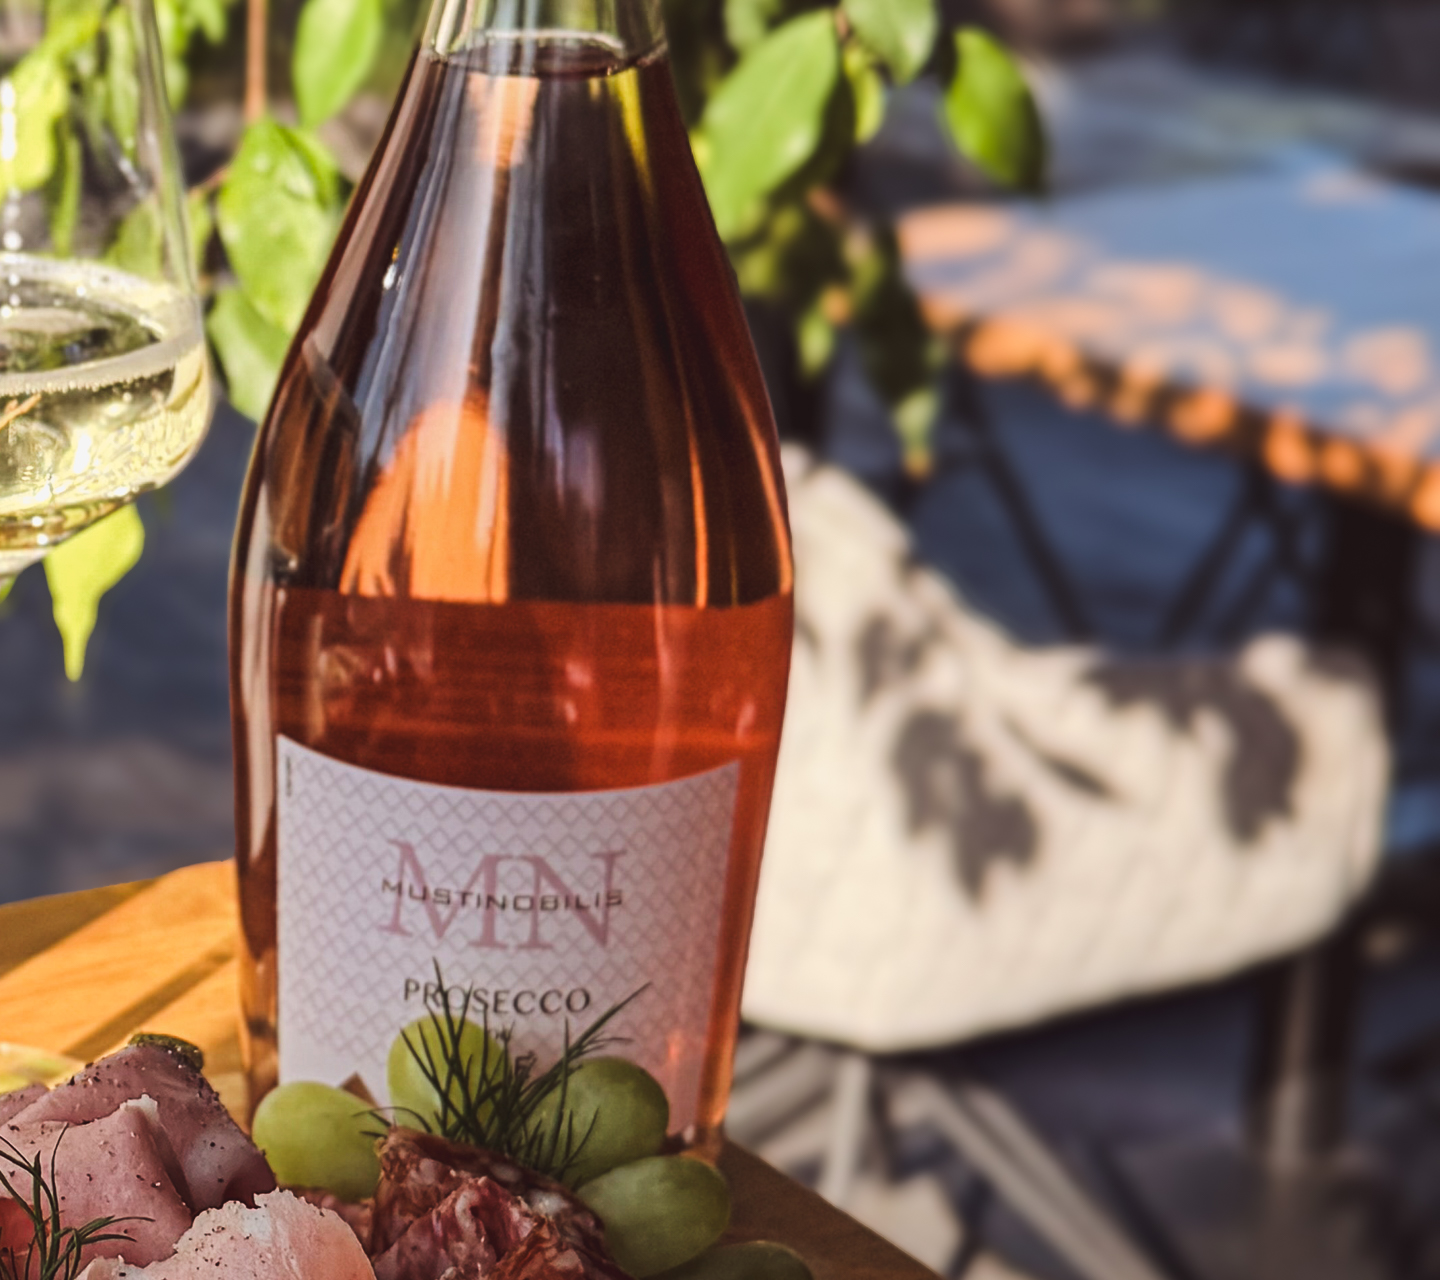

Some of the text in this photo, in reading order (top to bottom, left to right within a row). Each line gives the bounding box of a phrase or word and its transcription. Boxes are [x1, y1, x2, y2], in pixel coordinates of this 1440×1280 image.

[377, 837, 628, 950] MN
[381, 878, 623, 912] MUSTINOBILIS
[404, 977, 592, 1016] PROSECCO
